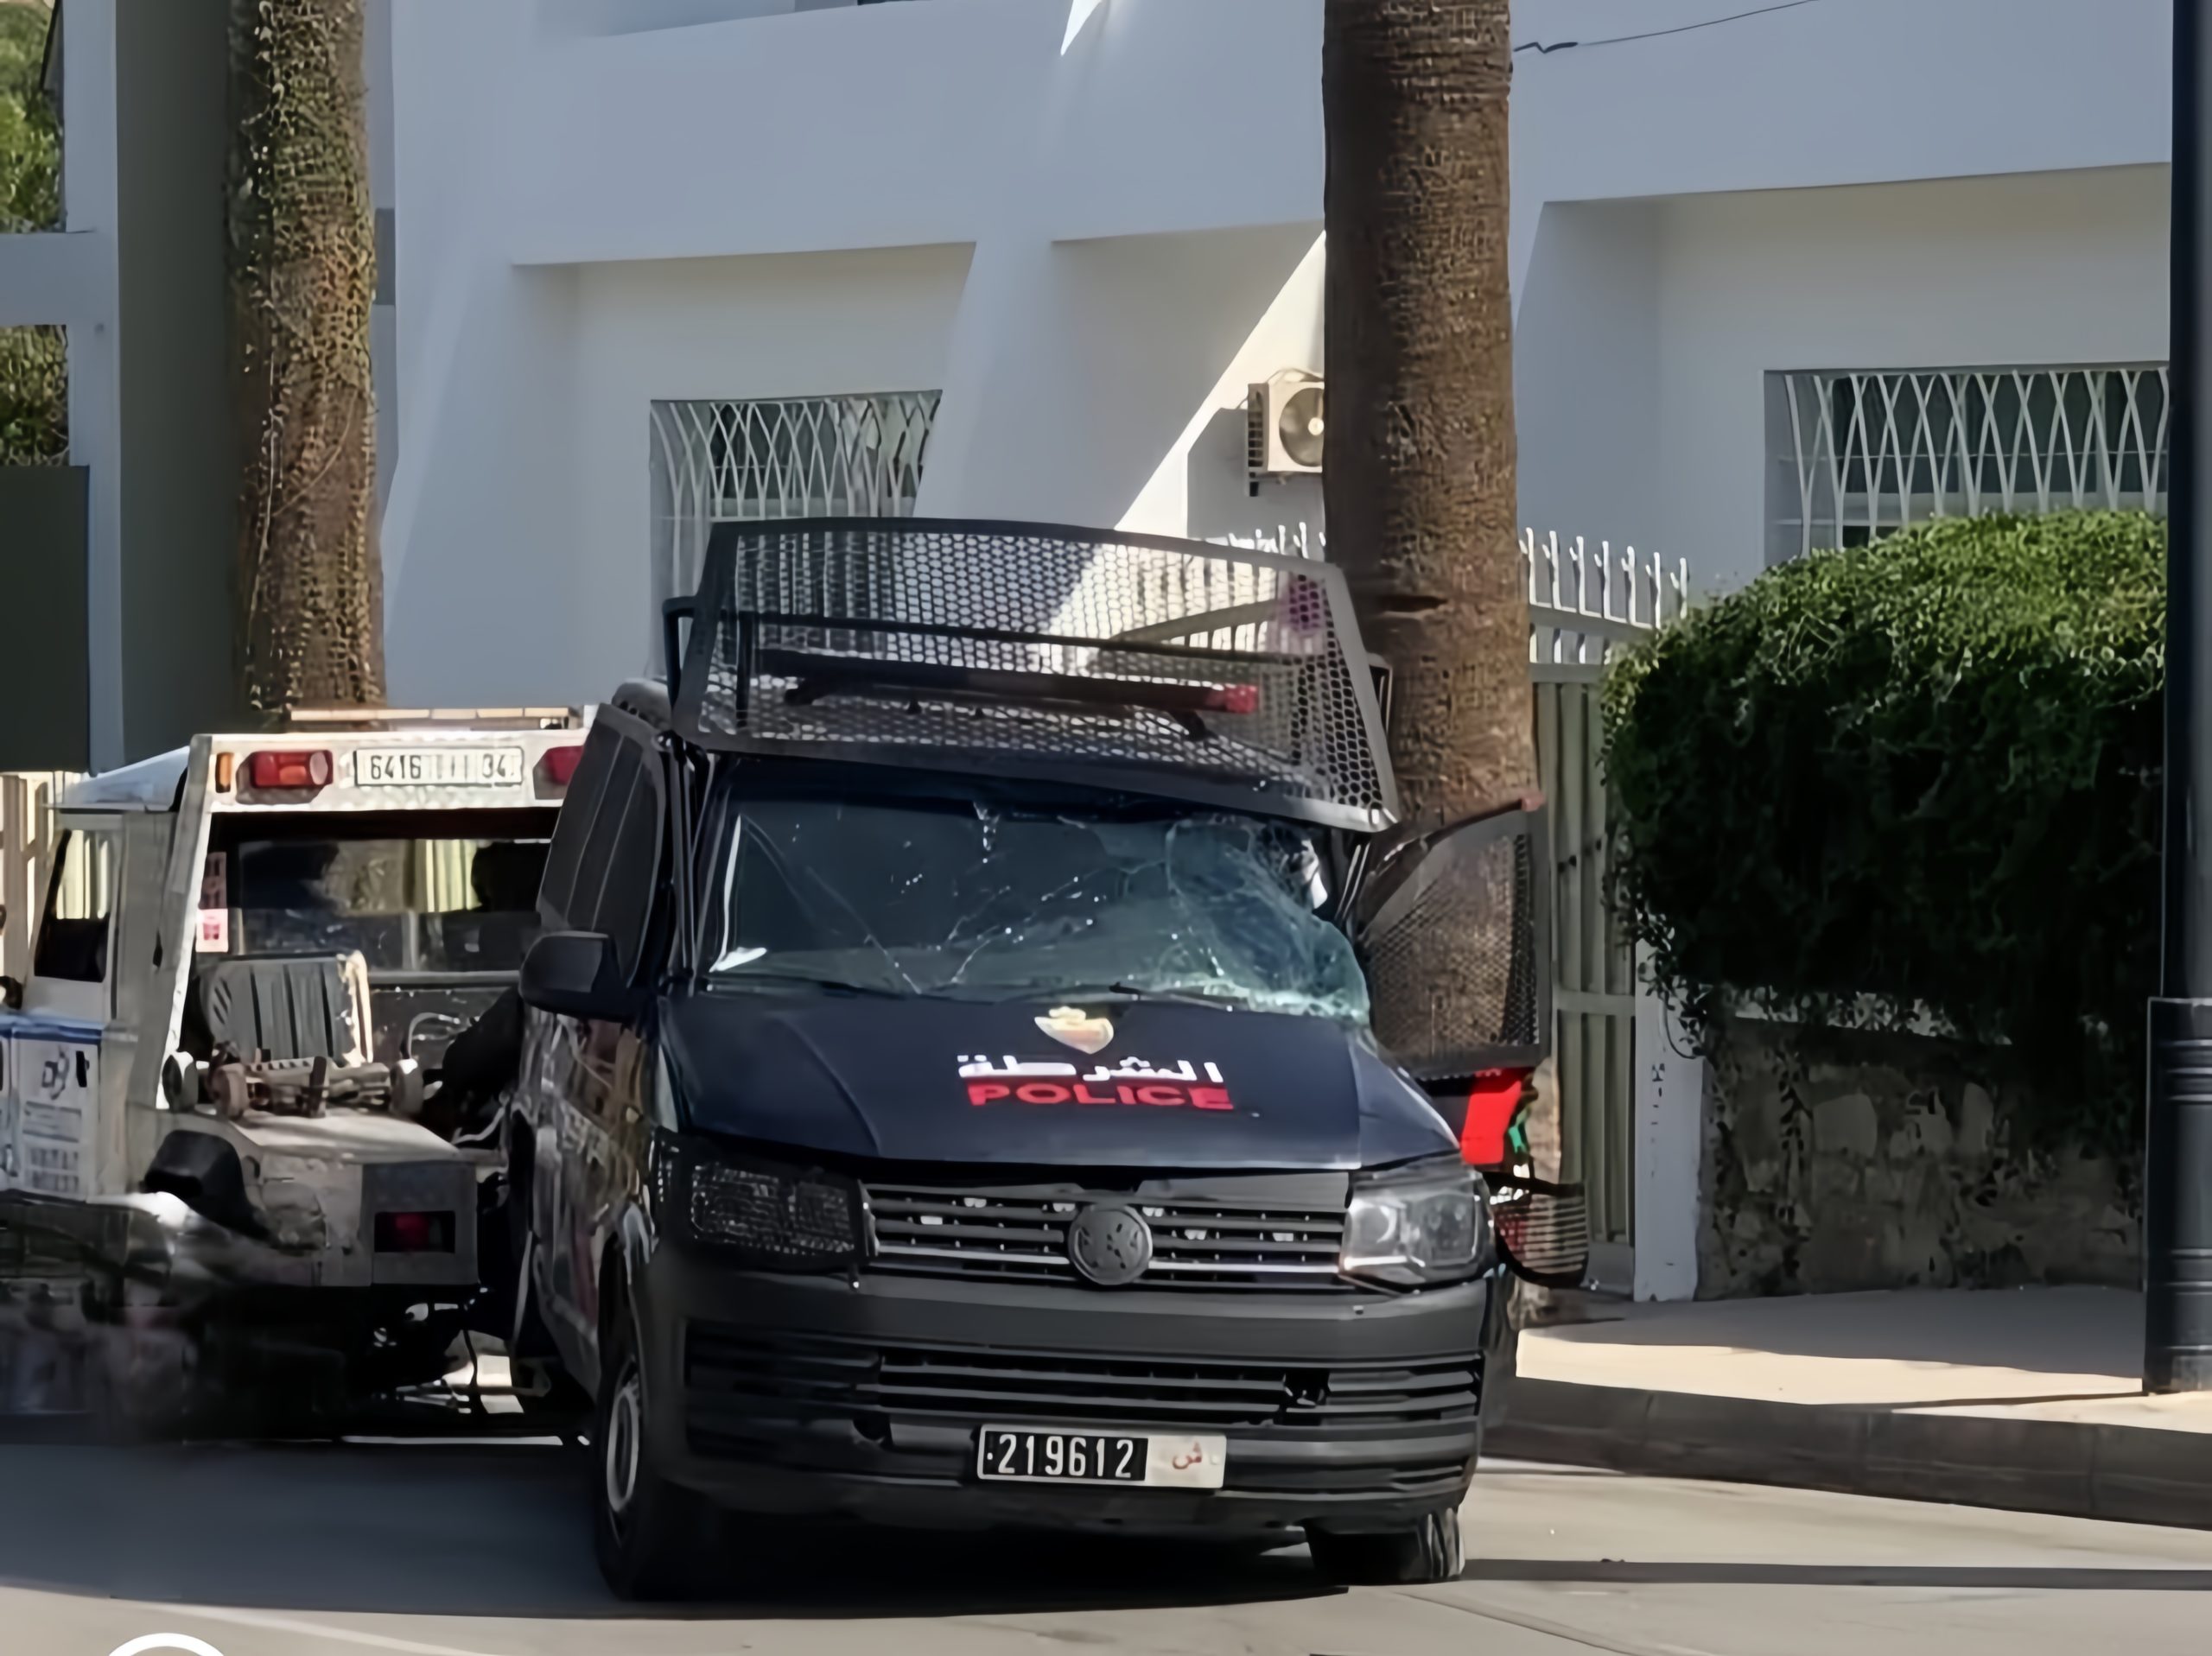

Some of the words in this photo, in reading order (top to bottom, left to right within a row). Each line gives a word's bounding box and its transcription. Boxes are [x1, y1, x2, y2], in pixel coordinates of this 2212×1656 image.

[957, 1055, 1224, 1083] الشرطة
[967, 1083, 1235, 1110] POLICE
[998, 1434, 1134, 1479] 219612
